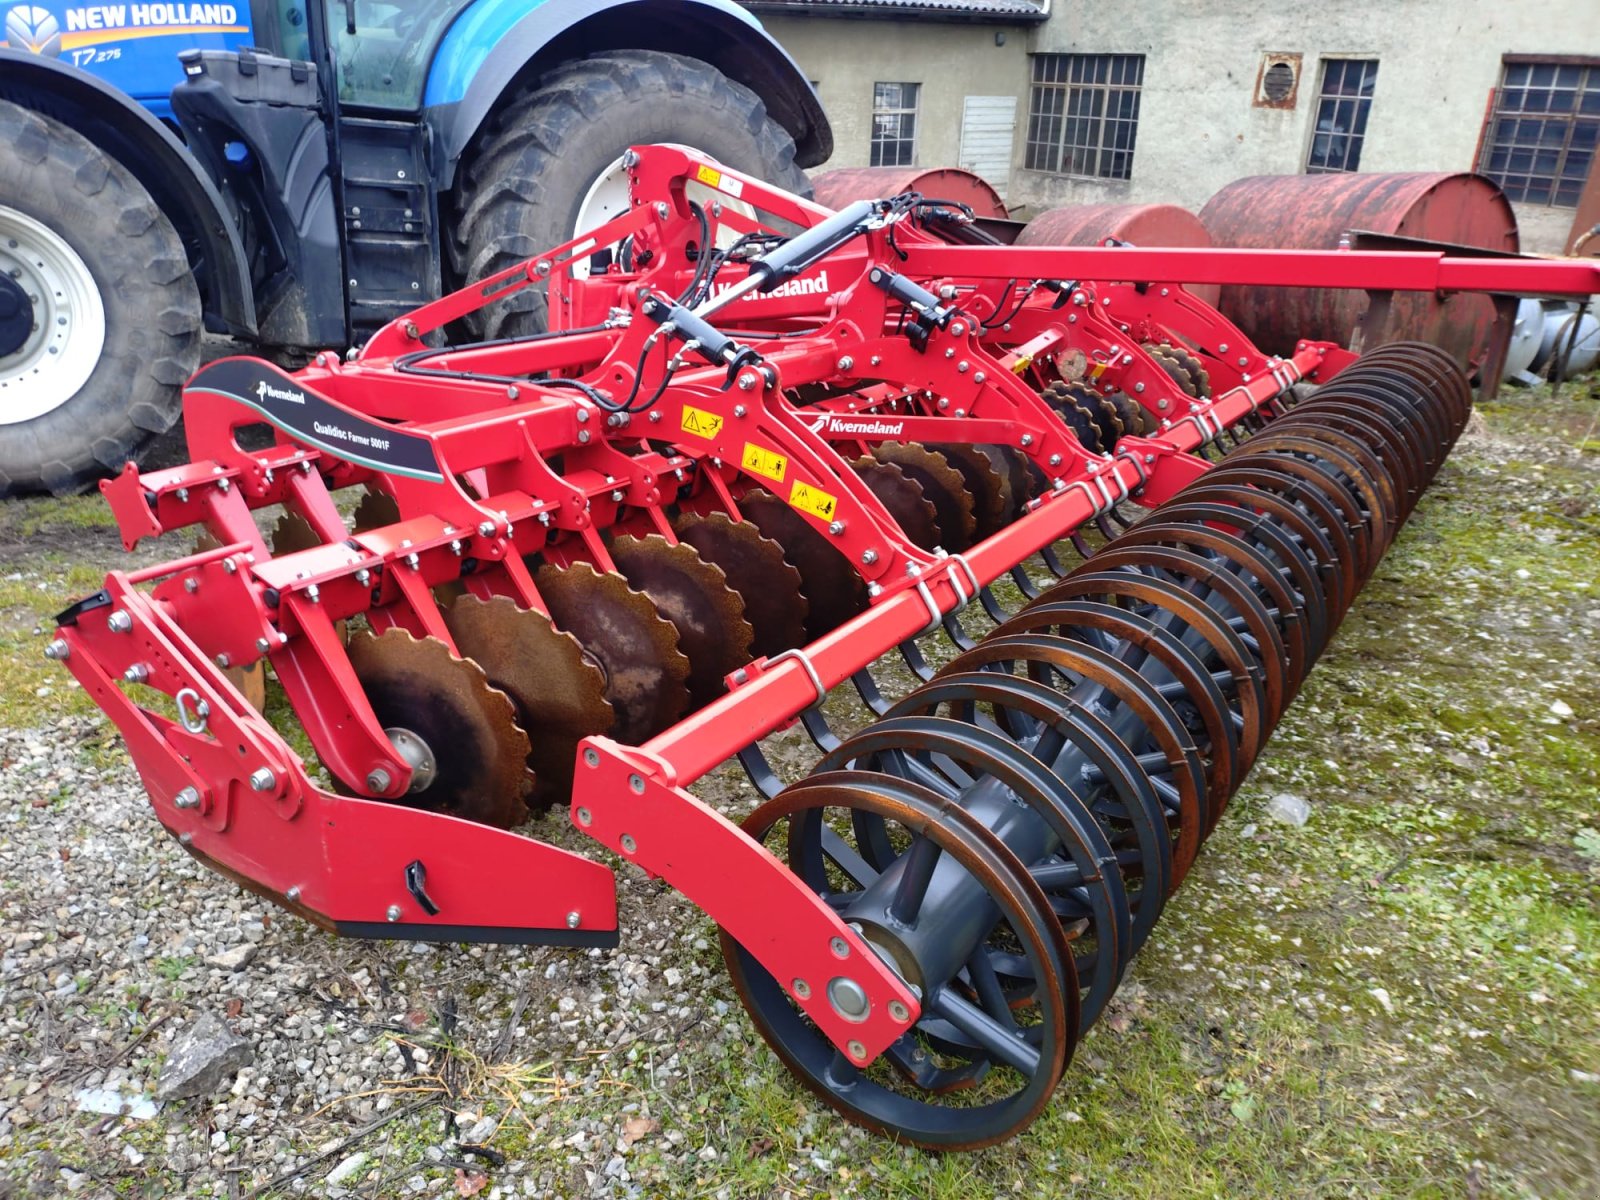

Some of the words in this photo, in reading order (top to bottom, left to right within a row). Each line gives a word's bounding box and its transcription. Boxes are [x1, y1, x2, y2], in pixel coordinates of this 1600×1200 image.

[66, 5, 126, 31] NEW
[131, 4, 237, 26] HOLLAND
[267, 385, 305, 404] Kverneland
[313, 421, 347, 440] Qualidisc
[347, 431, 370, 445] Farmer
[370, 437, 390, 451] 5001F
[830, 419, 903, 435] Kverneland
